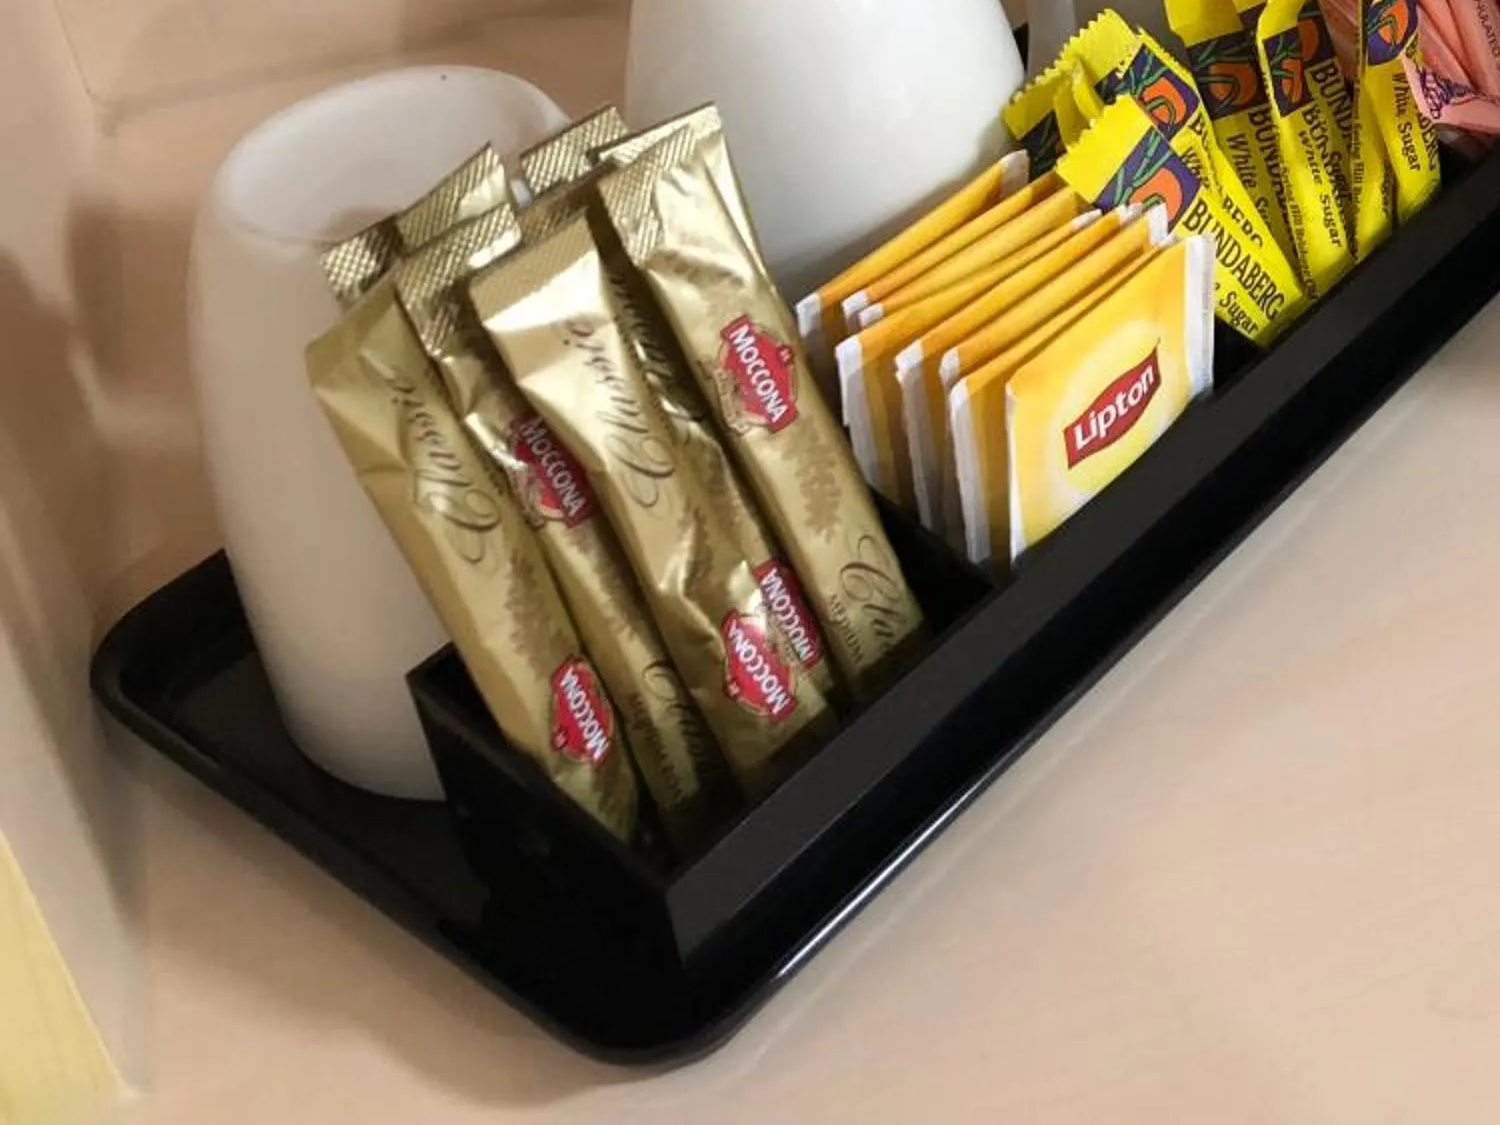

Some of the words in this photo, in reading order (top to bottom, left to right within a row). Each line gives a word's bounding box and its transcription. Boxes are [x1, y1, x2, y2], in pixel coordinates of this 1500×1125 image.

[1226, 131, 1257, 190] White
[1398, 122, 1420, 171] Sugar
[1320, 194, 1342, 248] Sugar
[1219, 290, 1259, 335] Sugar
[729, 324, 789, 423] MOCCONA
[1073, 364, 1155, 451] Lipton
[519, 416, 588, 519] MOCCONA
[760, 566, 815, 663] MOCCONA
[728, 618, 790, 716] MOCCONA
[558, 666, 611, 762] MOCCONA
